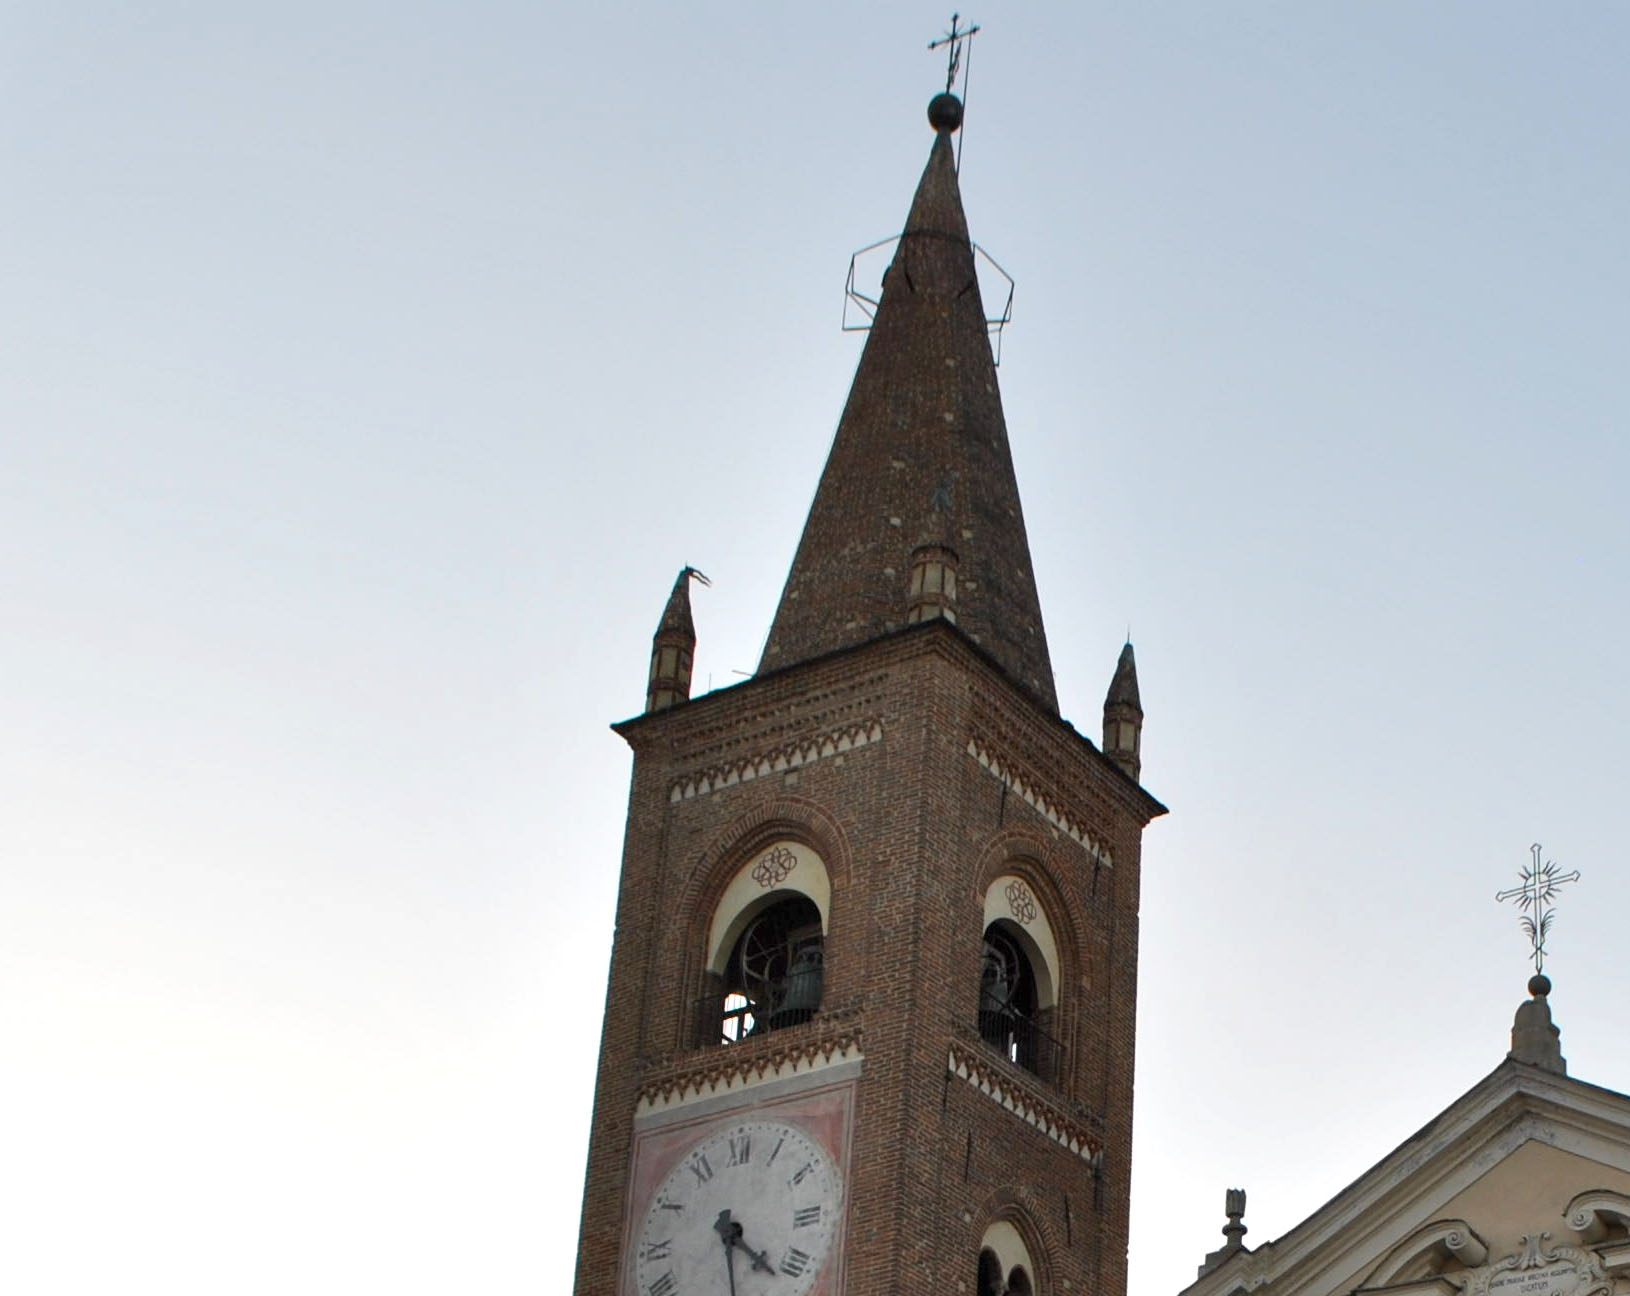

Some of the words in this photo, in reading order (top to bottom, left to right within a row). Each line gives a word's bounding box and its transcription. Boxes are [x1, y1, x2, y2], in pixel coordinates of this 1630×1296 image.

[727, 1135, 751, 1168] XII
[766, 1138, 785, 1168] I
[689, 1154, 713, 1189] XI
[793, 1205, 822, 1230] III
[646, 1239, 673, 1263] IX
[779, 1246, 811, 1279] IIII
